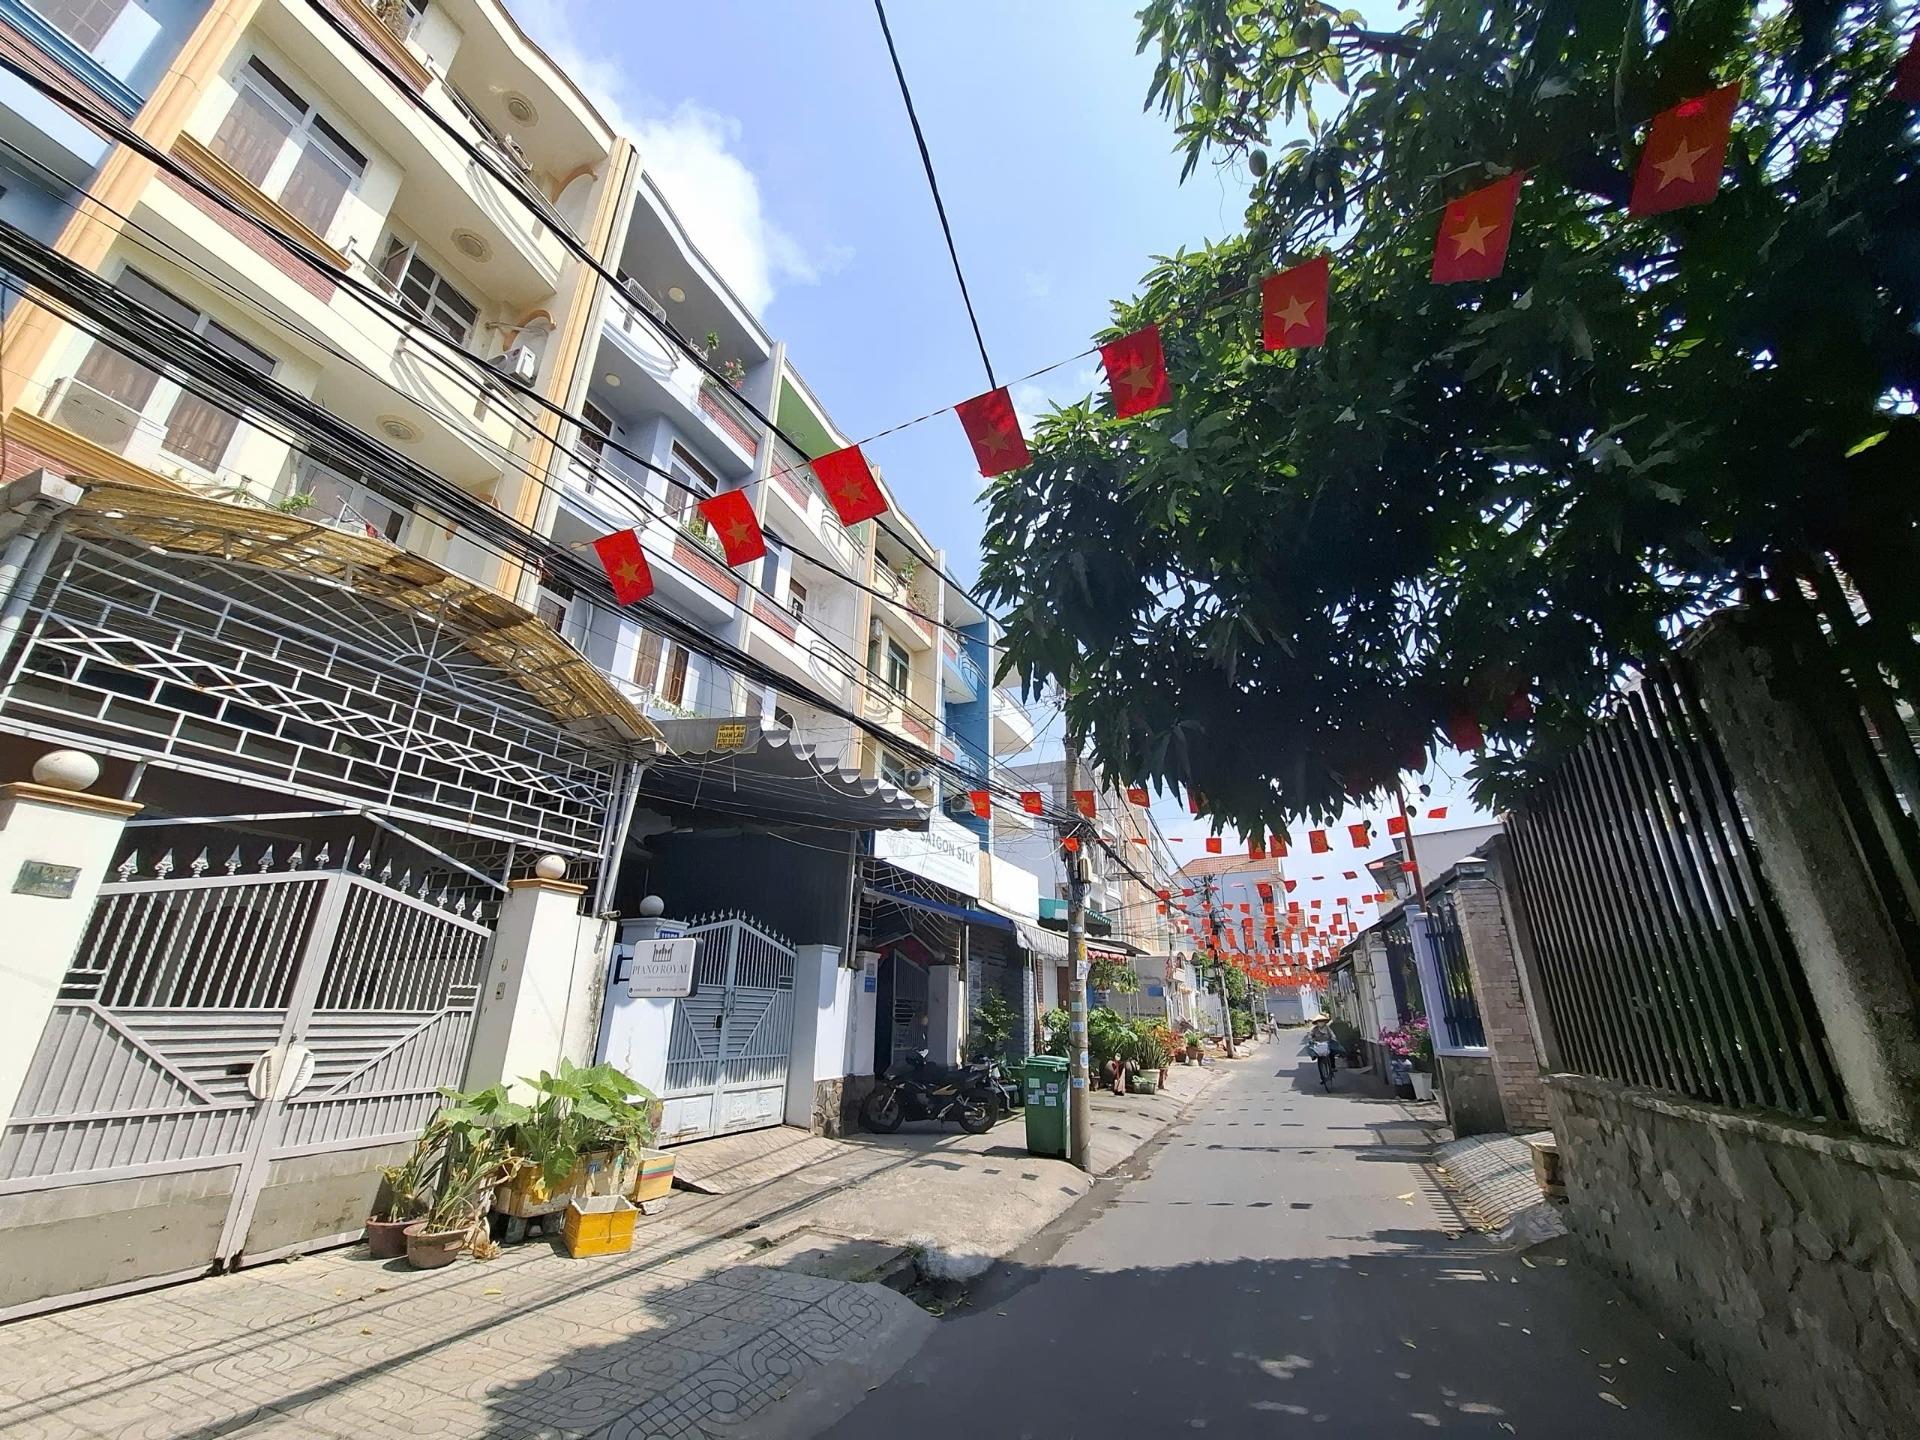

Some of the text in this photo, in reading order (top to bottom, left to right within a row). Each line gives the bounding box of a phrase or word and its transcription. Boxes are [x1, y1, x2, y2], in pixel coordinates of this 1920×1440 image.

[920, 831, 976, 866] SAIGON SILK
[632, 963, 688, 975] PIANO ROYAL
